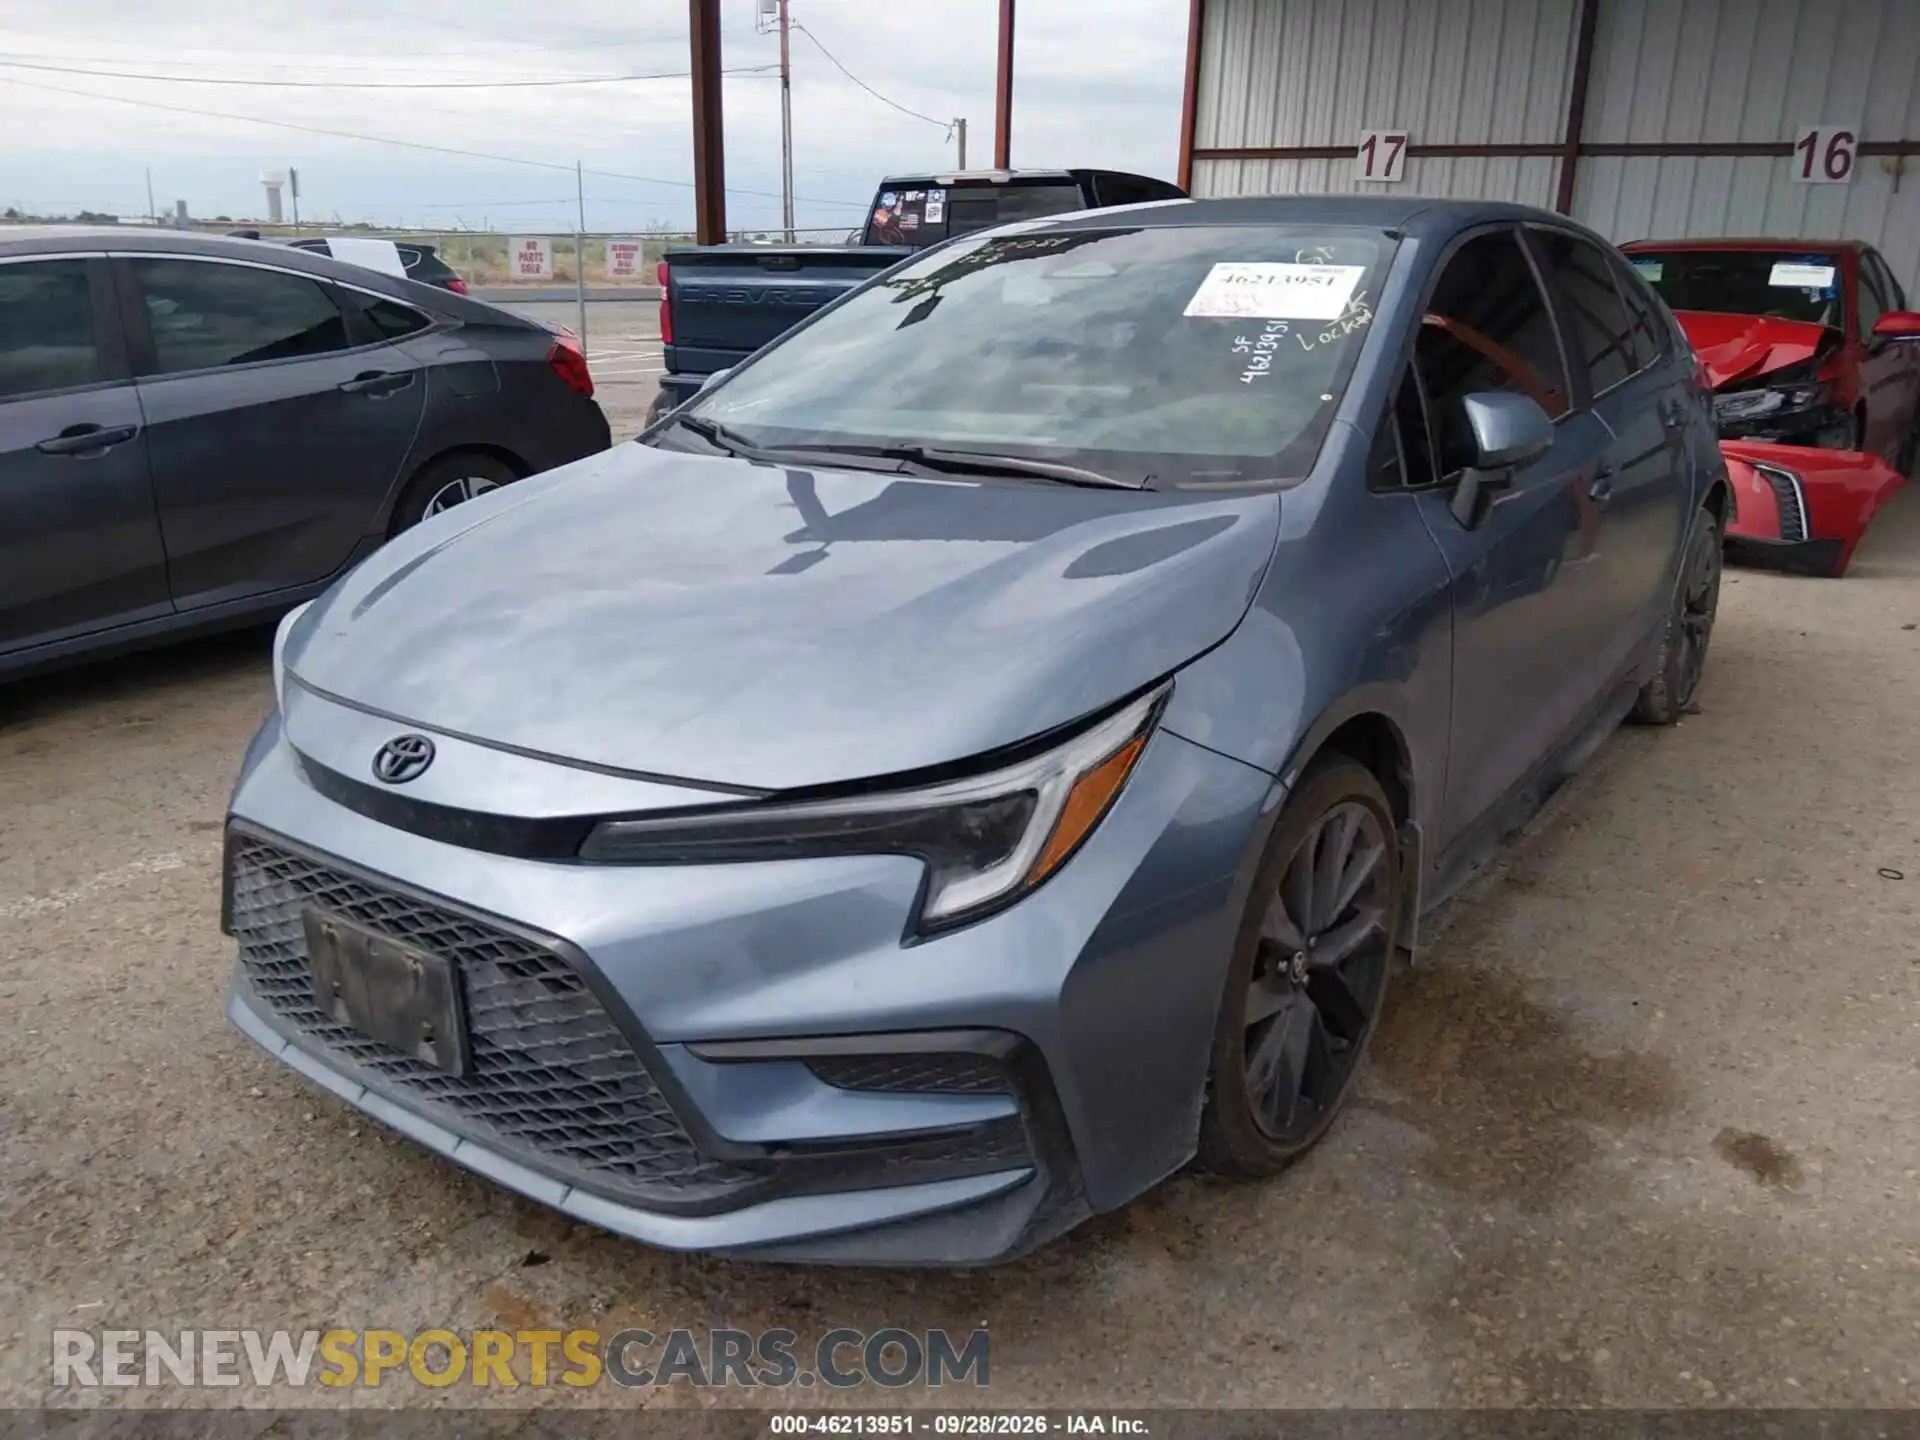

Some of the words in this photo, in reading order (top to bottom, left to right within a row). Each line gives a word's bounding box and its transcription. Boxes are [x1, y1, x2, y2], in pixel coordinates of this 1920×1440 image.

[1361, 134, 1406, 177] 17
[1797, 131, 1854, 180] 16
[518, 251, 544, 263] PARTS
[526, 240, 538, 250] NO
[680, 286, 829, 306] CHEVRO
[1239, 320, 1289, 384] 46213951
